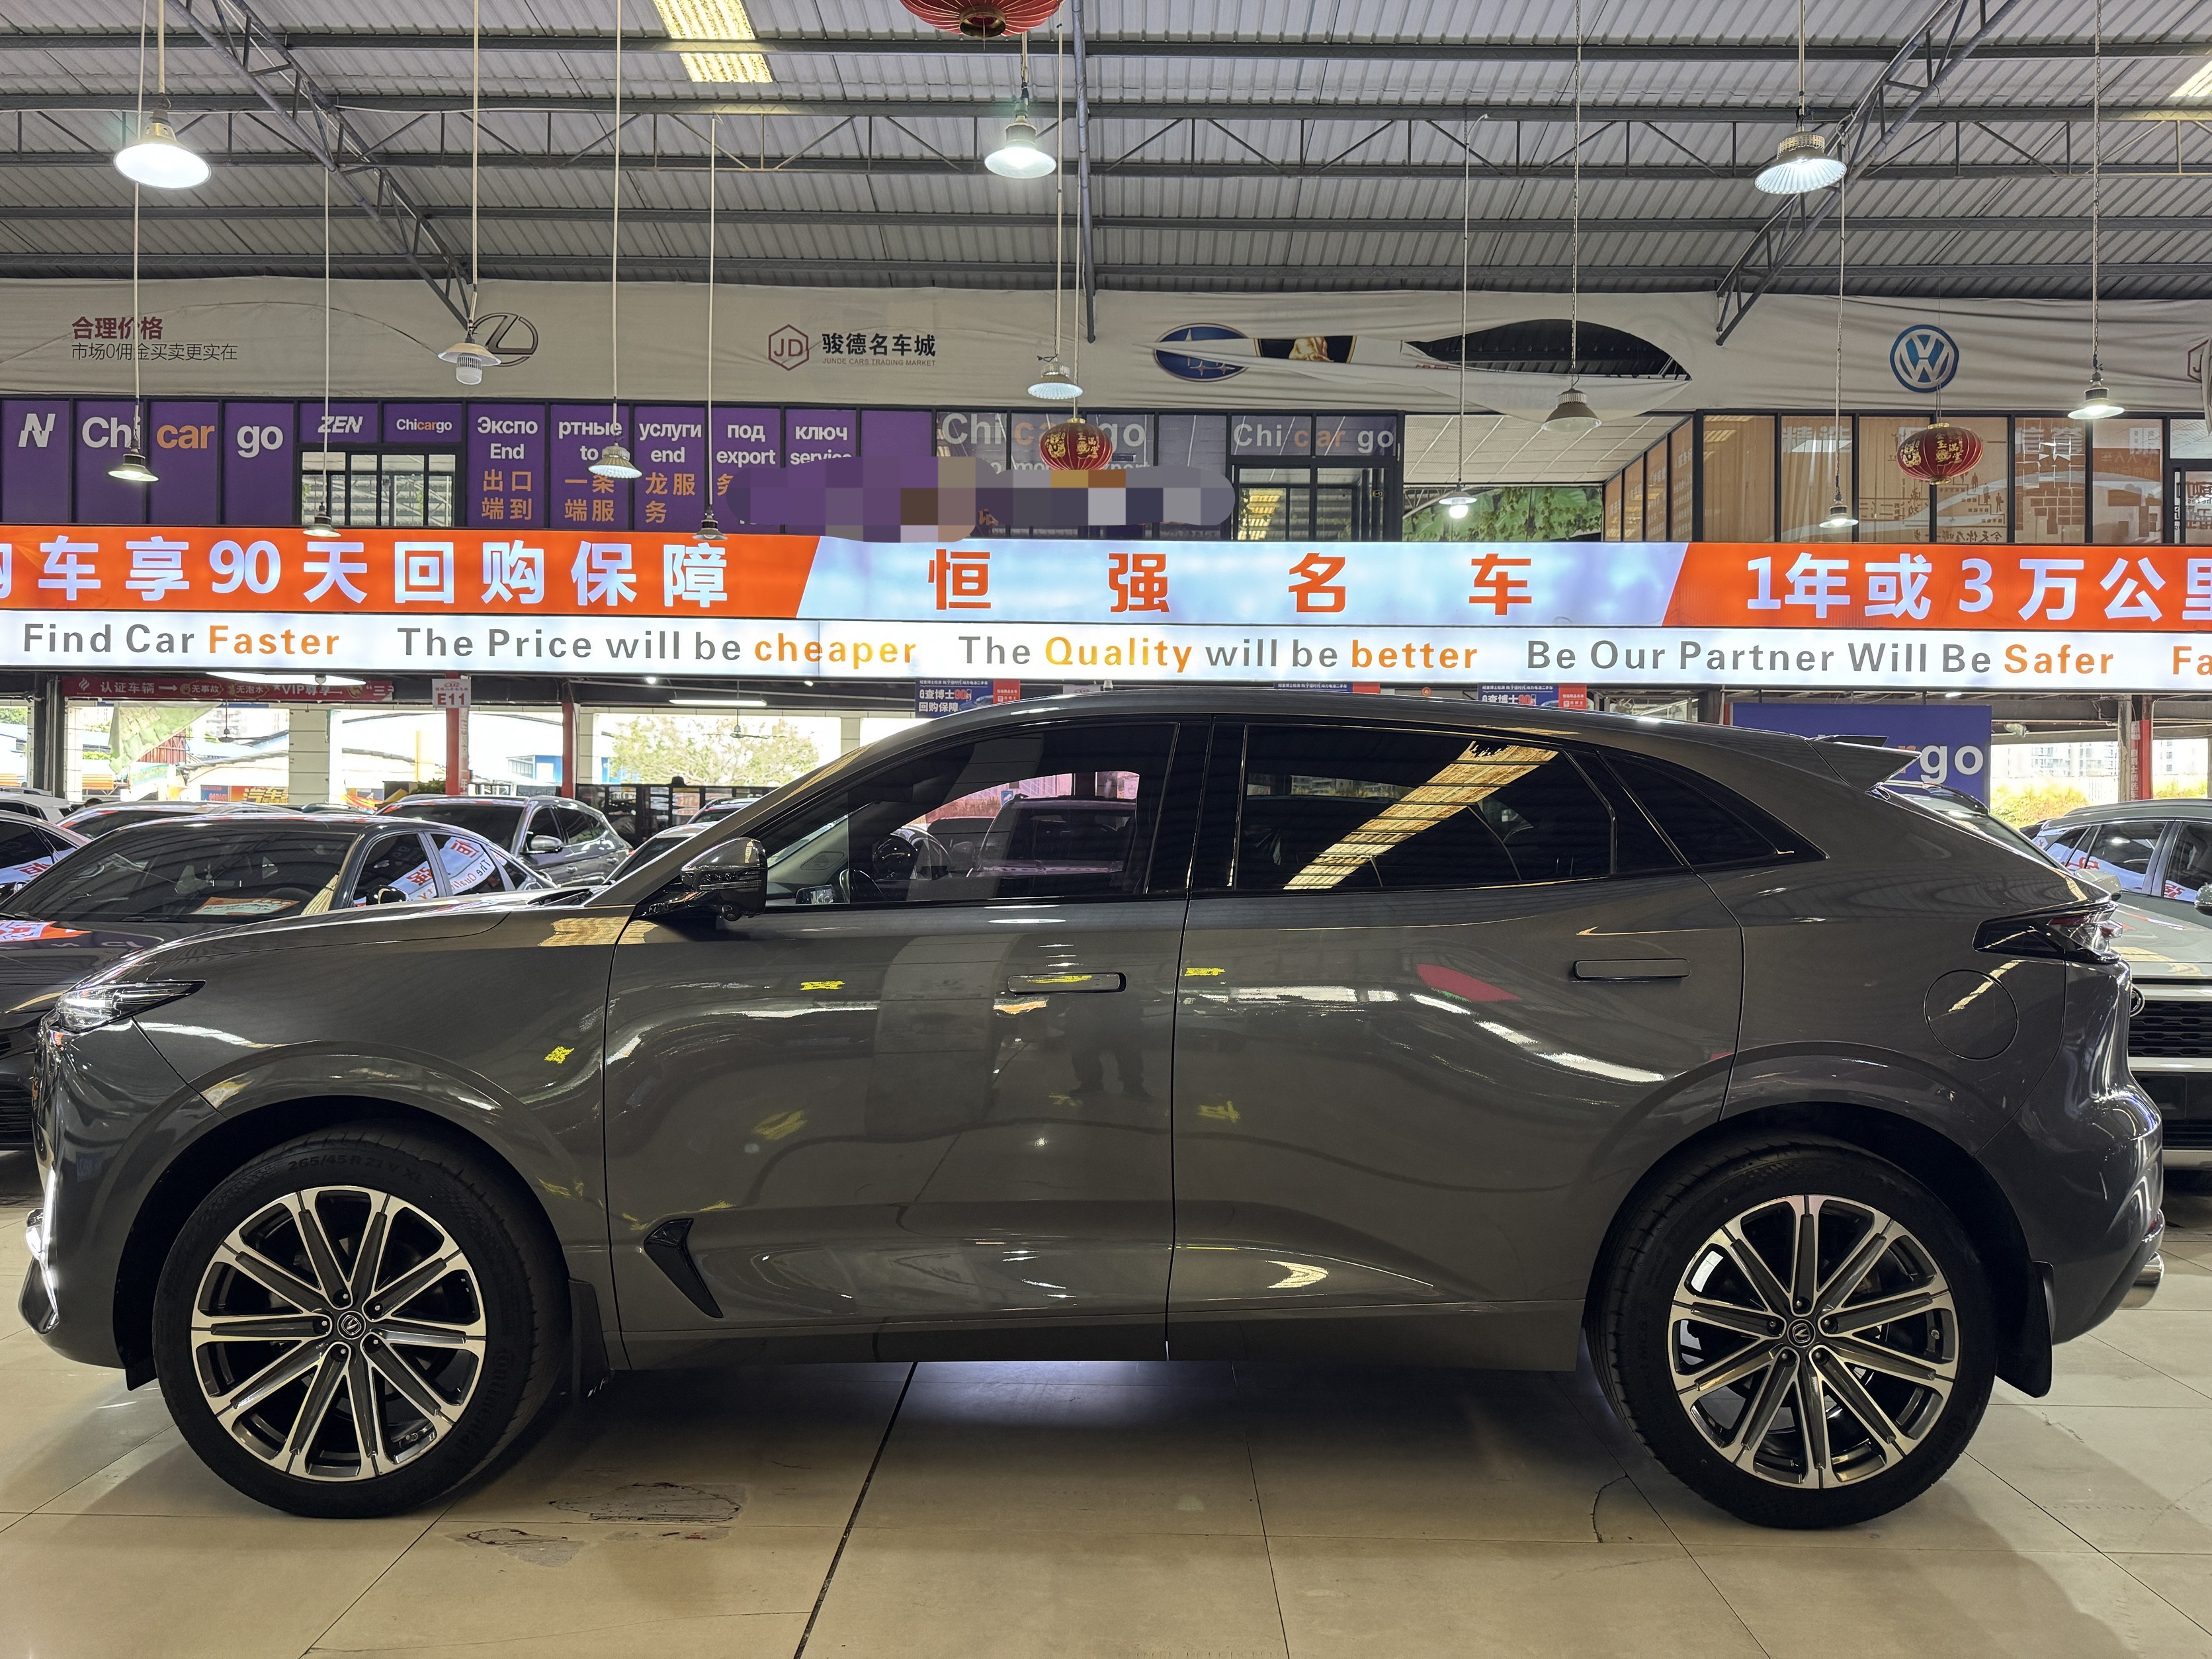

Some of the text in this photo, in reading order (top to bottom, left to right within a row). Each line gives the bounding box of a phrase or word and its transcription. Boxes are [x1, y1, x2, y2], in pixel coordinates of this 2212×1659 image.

[71, 316, 163, 340] 合理价格
[71, 343, 238, 361] 市场0佣金买卖更实在
[773, 338, 804, 357] JD
[822, 333, 936, 357] 骏德名车城
[318, 415, 363, 433] ZEN
[396, 418, 452, 434] Chicargo
[477, 416, 848, 442] Экспо ртные услуги под ключ
[942, 413, 1002, 445] Chi
[156, 425, 216, 449] car
[237, 425, 284, 458] go
[1233, 423, 1394, 453] Chi car go
[490, 443, 853, 468] End to end export servi
[483, 469, 532, 491] 出口
[565, 473, 615, 493] 一条
[645, 472, 696, 496] 龙服
[482, 497, 667, 523] 端到 端服 务
[0, 535, 728, 607] 车享90天回购保障
[928, 548, 1533, 616] 恒强名车
[24, 623, 111, 653] Find
[126, 624, 194, 654] Car
[210, 625, 339, 655] Faster
[398, 628, 474, 657] The
[489, 628, 591, 658] Price
[606, 630, 679, 659] will
[696, 632, 741, 661] be
[755, 633, 916, 670] cheaper
[958, 636, 1031, 665] The
[1045, 636, 1192, 673] Quality
[1205, 638, 1277, 667] will
[1293, 639, 1338, 667] be
[1352, 640, 1478, 669] better
[1528, 640, 1576, 669] Be
[1591, 640, 1666, 669] Our
[1680, 641, 1834, 671] Partner
[1848, 643, 1926, 672] Will
[1943, 644, 1991, 673] Be
[2005, 644, 2114, 674] Safer
[100, 681, 155, 694] 认证车辆
[191, 684, 220, 693] 无事故
[236, 685, 264, 694] 无泡水
[437, 693, 464, 705] E11
[918, 702, 958, 712] 回购保障
